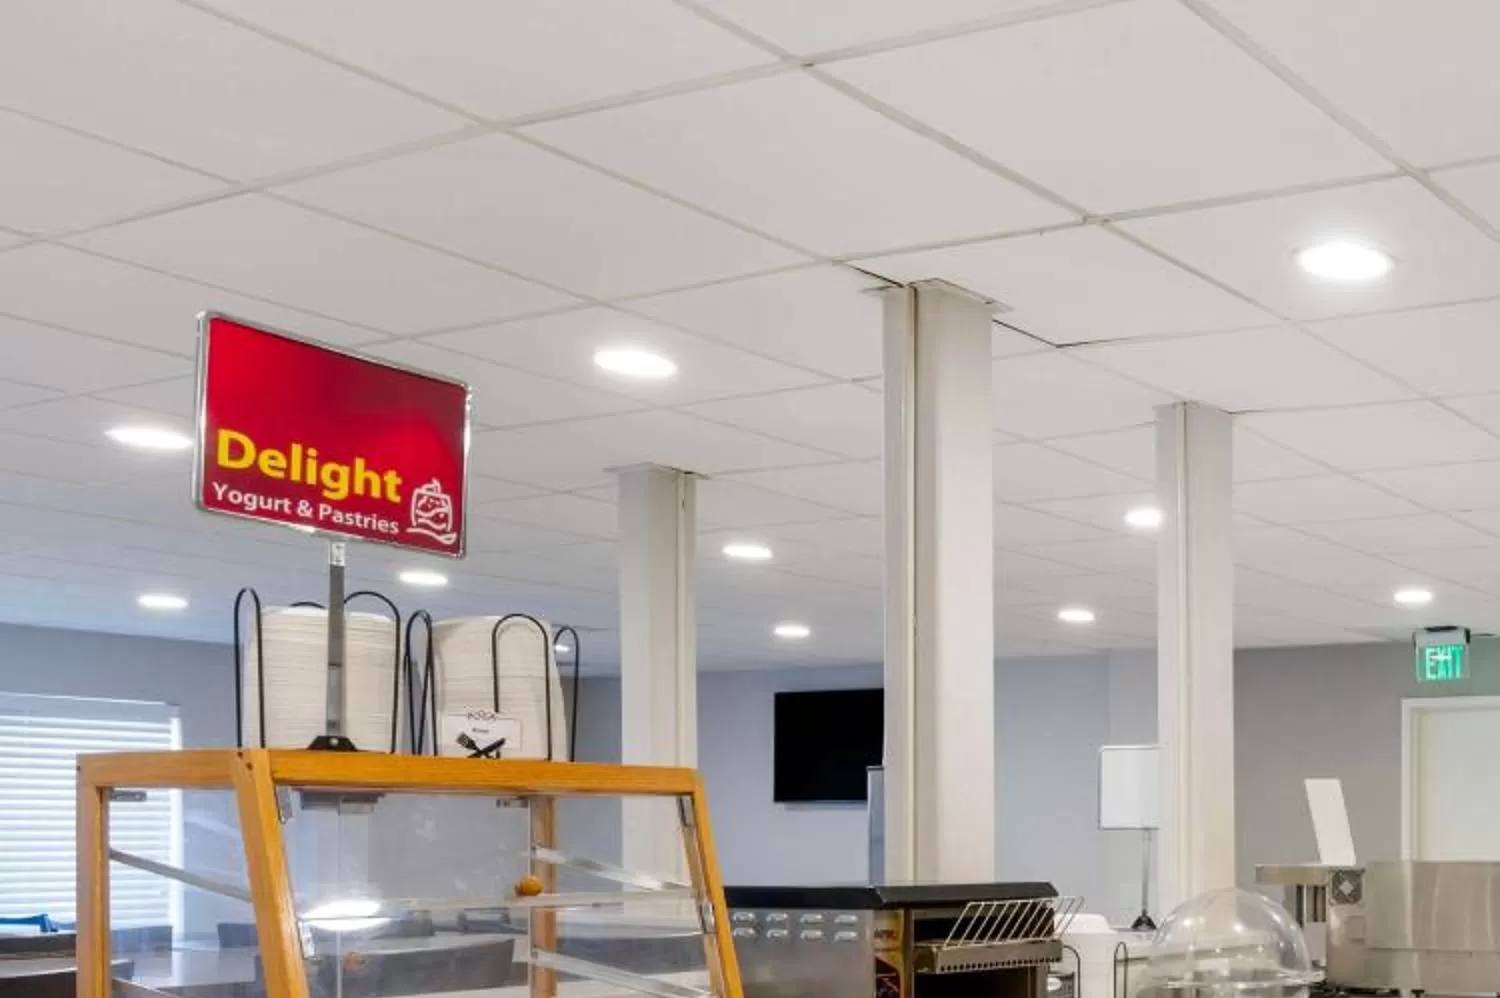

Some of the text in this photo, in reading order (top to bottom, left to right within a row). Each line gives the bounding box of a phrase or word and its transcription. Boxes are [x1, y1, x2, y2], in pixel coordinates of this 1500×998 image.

[216, 428, 403, 503] Delight
[212, 482, 400, 535] Yogurt & Pastries
[1425, 646, 1464, 680] EXIT
